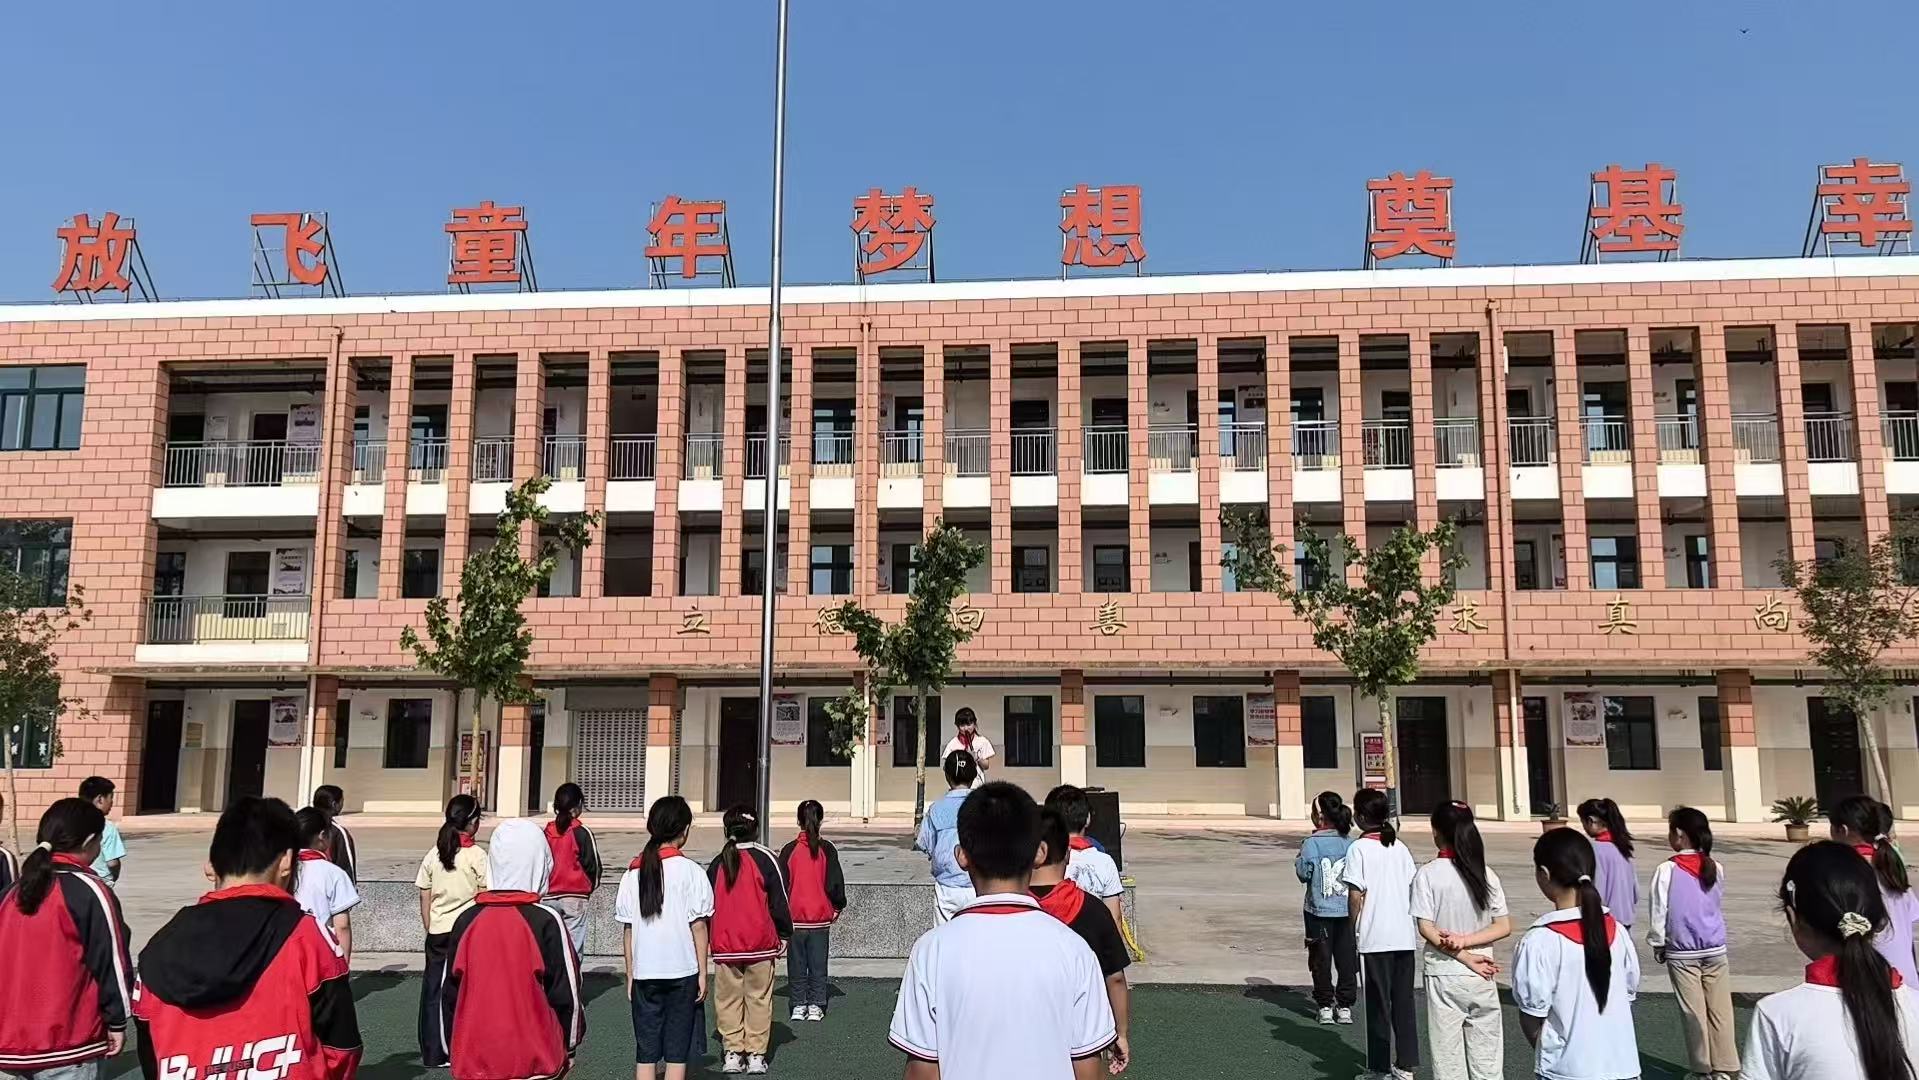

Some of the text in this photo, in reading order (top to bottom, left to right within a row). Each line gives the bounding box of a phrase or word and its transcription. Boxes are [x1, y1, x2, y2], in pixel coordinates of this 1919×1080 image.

[52, 157, 1913, 293] 放飞童年梦想 奠基幸
